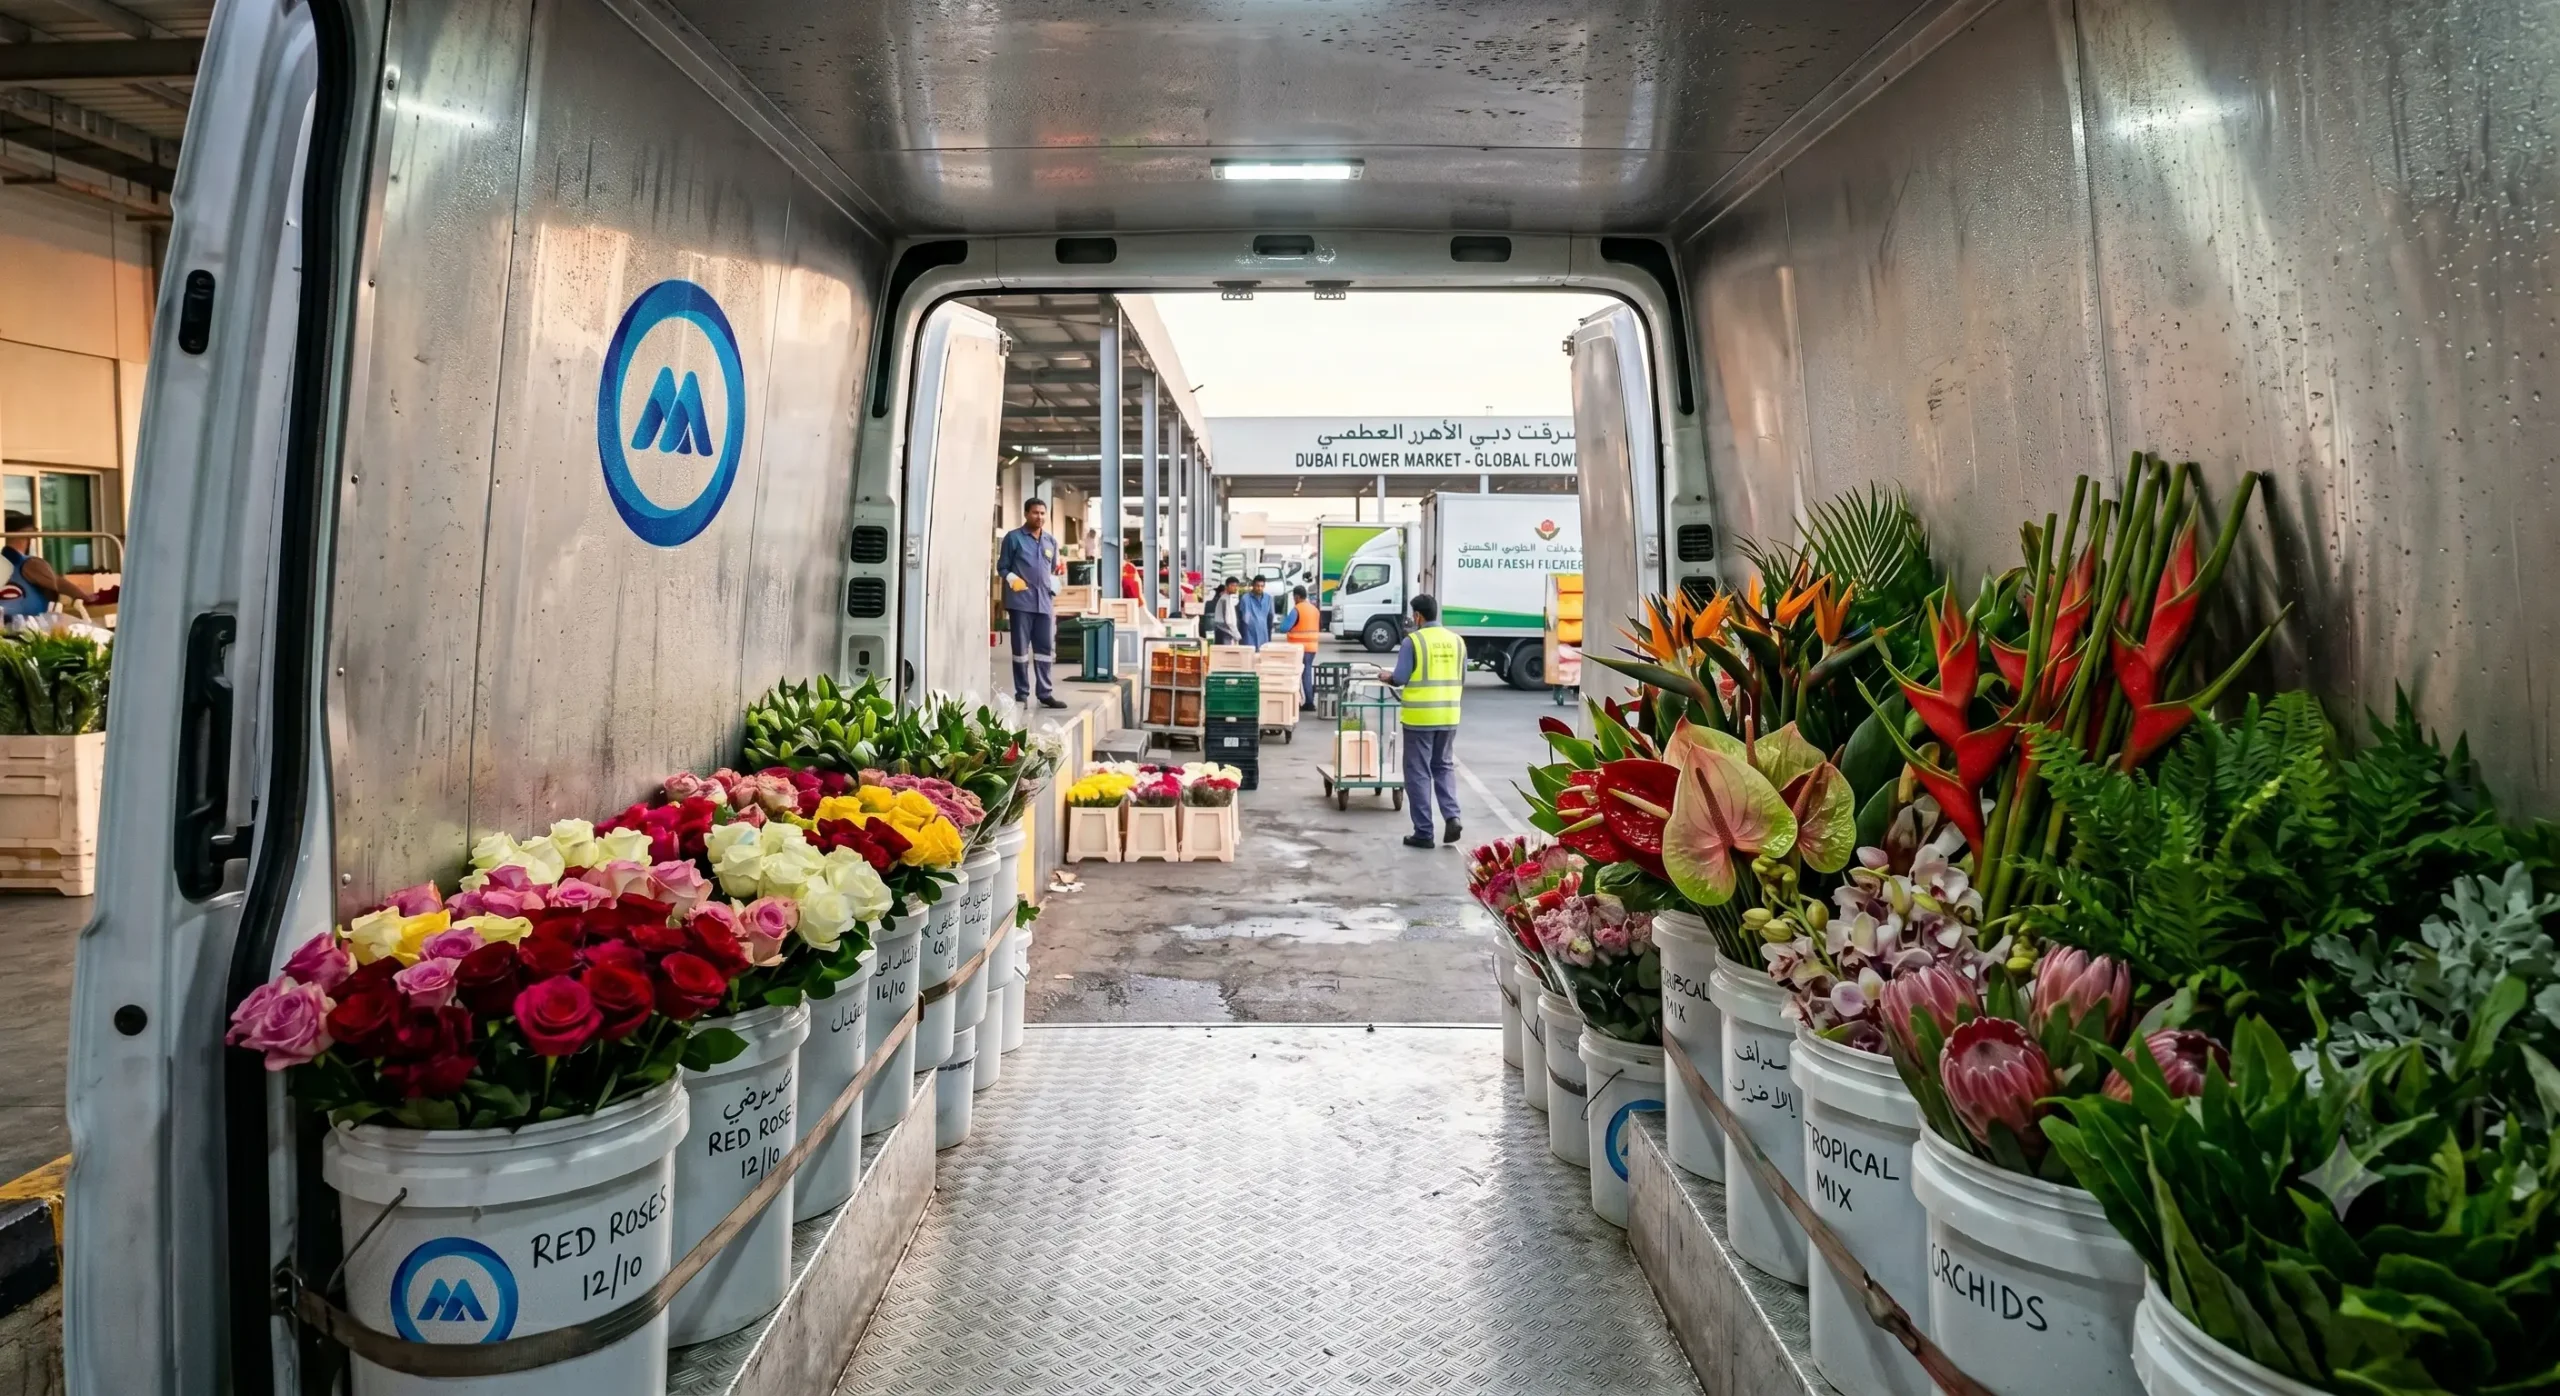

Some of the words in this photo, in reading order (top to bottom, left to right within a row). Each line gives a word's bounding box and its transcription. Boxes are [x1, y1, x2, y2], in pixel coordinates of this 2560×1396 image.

[1469, 427, 1512, 450] دبي
[1295, 453, 1338, 468] DUBAI
[1342, 453, 1400, 468] FLOWER
[1404, 453, 1462, 468] MARKET
[1475, 453, 1531, 468] GLOBAL
[1535, 453, 1577, 468] FLOW
[1457, 558, 1493, 569] DUBAI
[1497, 558, 1535, 570] FAESH
[876, 979, 906, 1004] 16/10
[1665, 995, 1686, 1023] MIX
[708, 1127, 751, 1157] RED
[1804, 1120, 1900, 1181] TROPICAL
[741, 1146, 780, 1181] 12/10
[1816, 1169, 1852, 1212] MIX
[530, 1226, 596, 1269] RED
[610, 1183, 667, 1244] ROSES
[583, 1253, 642, 1301] 12/10
[1931, 1242, 2048, 1332] ORCHIDS
